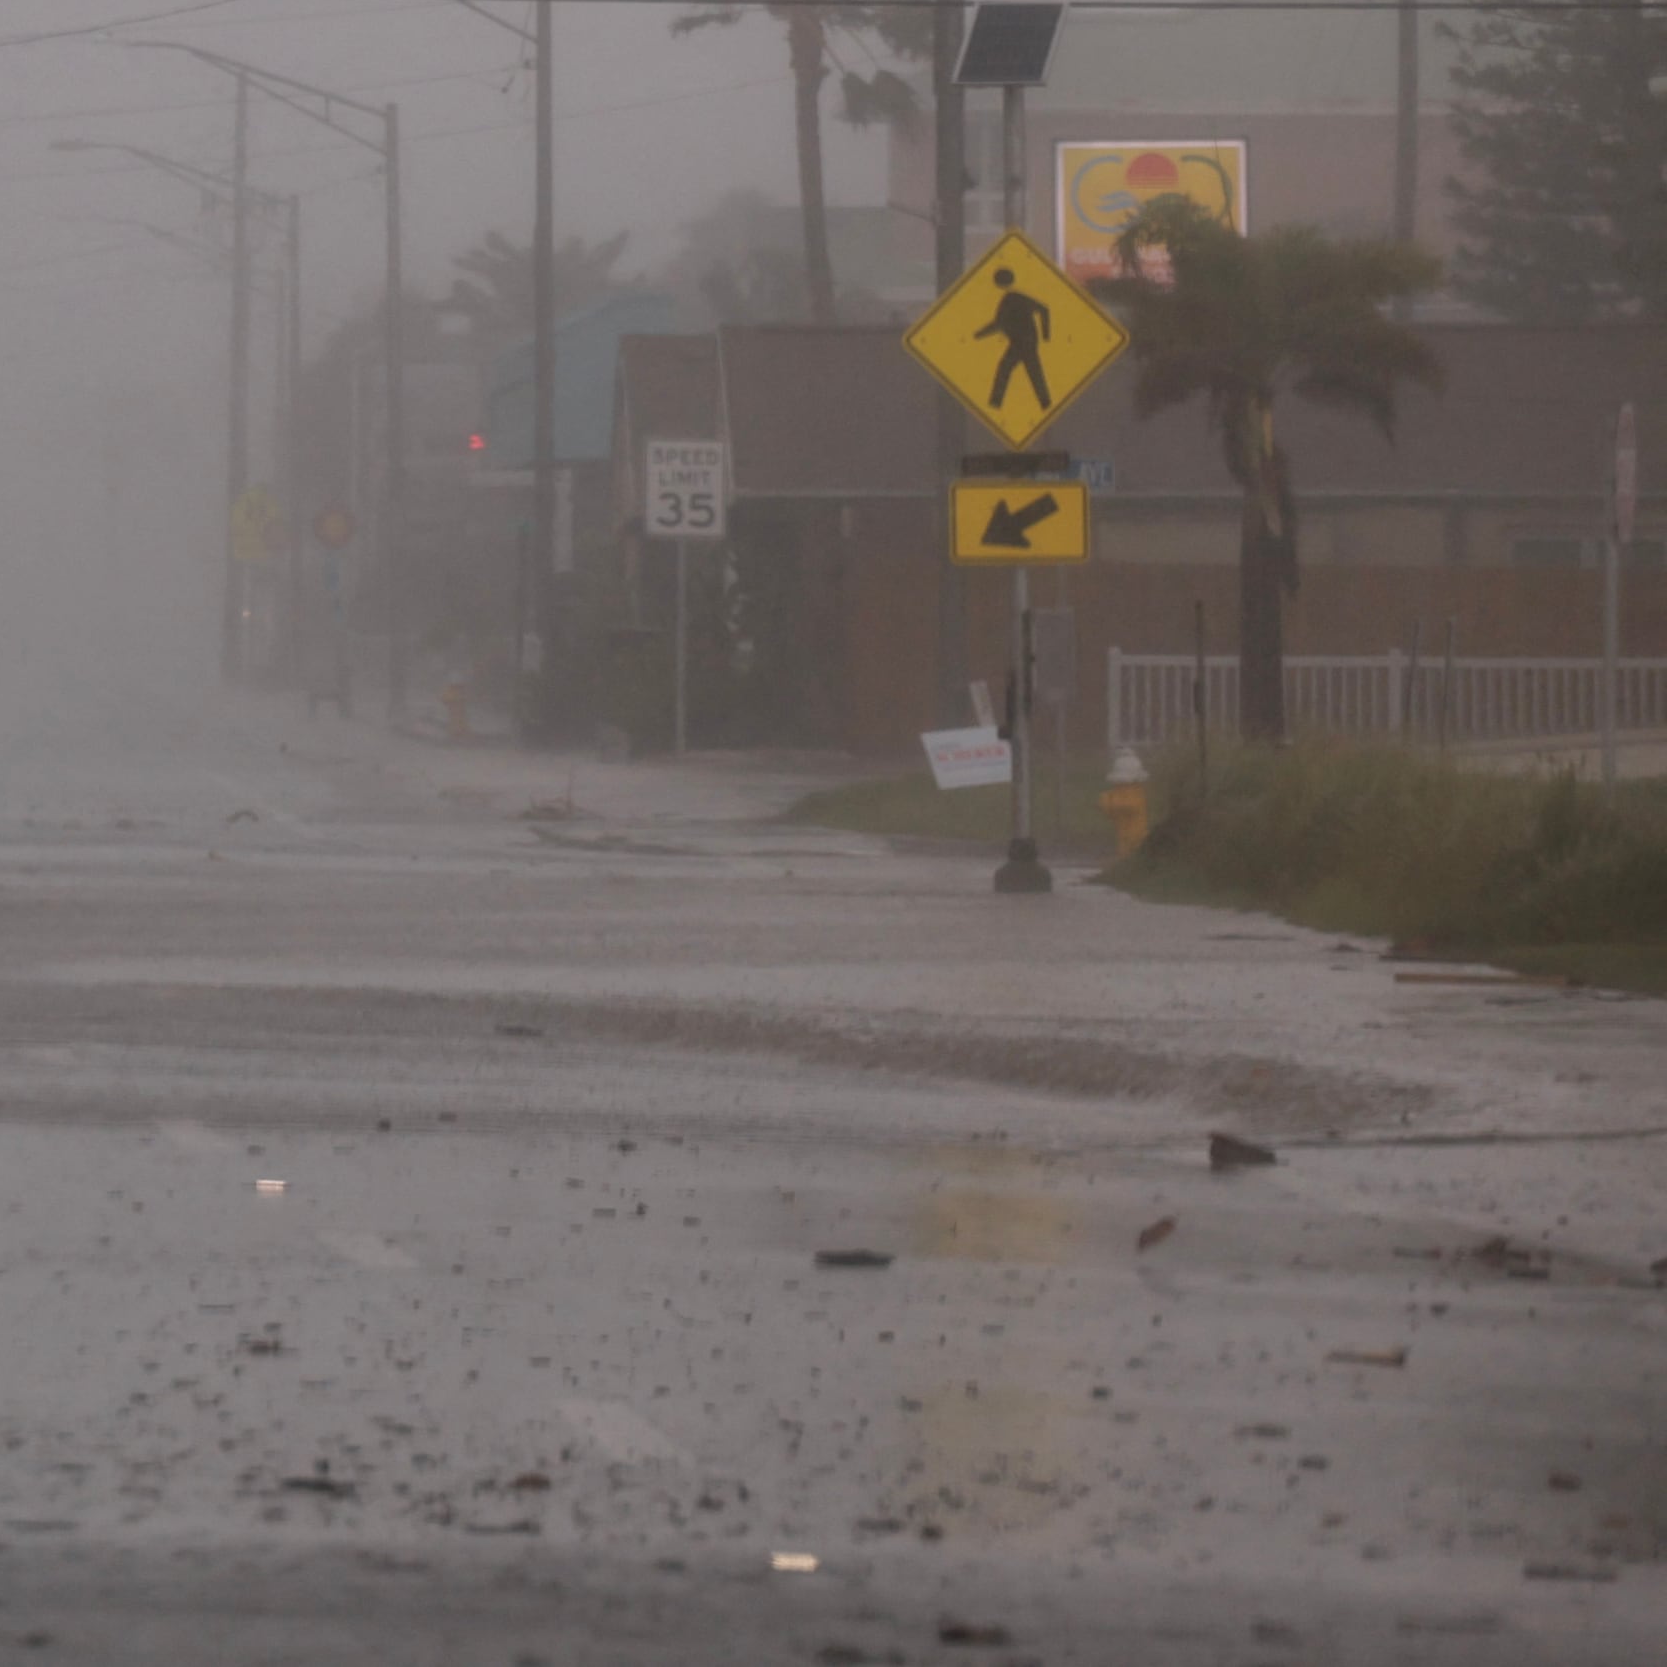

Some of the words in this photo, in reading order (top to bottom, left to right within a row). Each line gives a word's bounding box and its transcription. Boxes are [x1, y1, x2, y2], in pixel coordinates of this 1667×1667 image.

[652, 447, 719, 466] SPEED
[659, 470, 710, 487] LIMIT
[656, 492, 716, 528] 35
